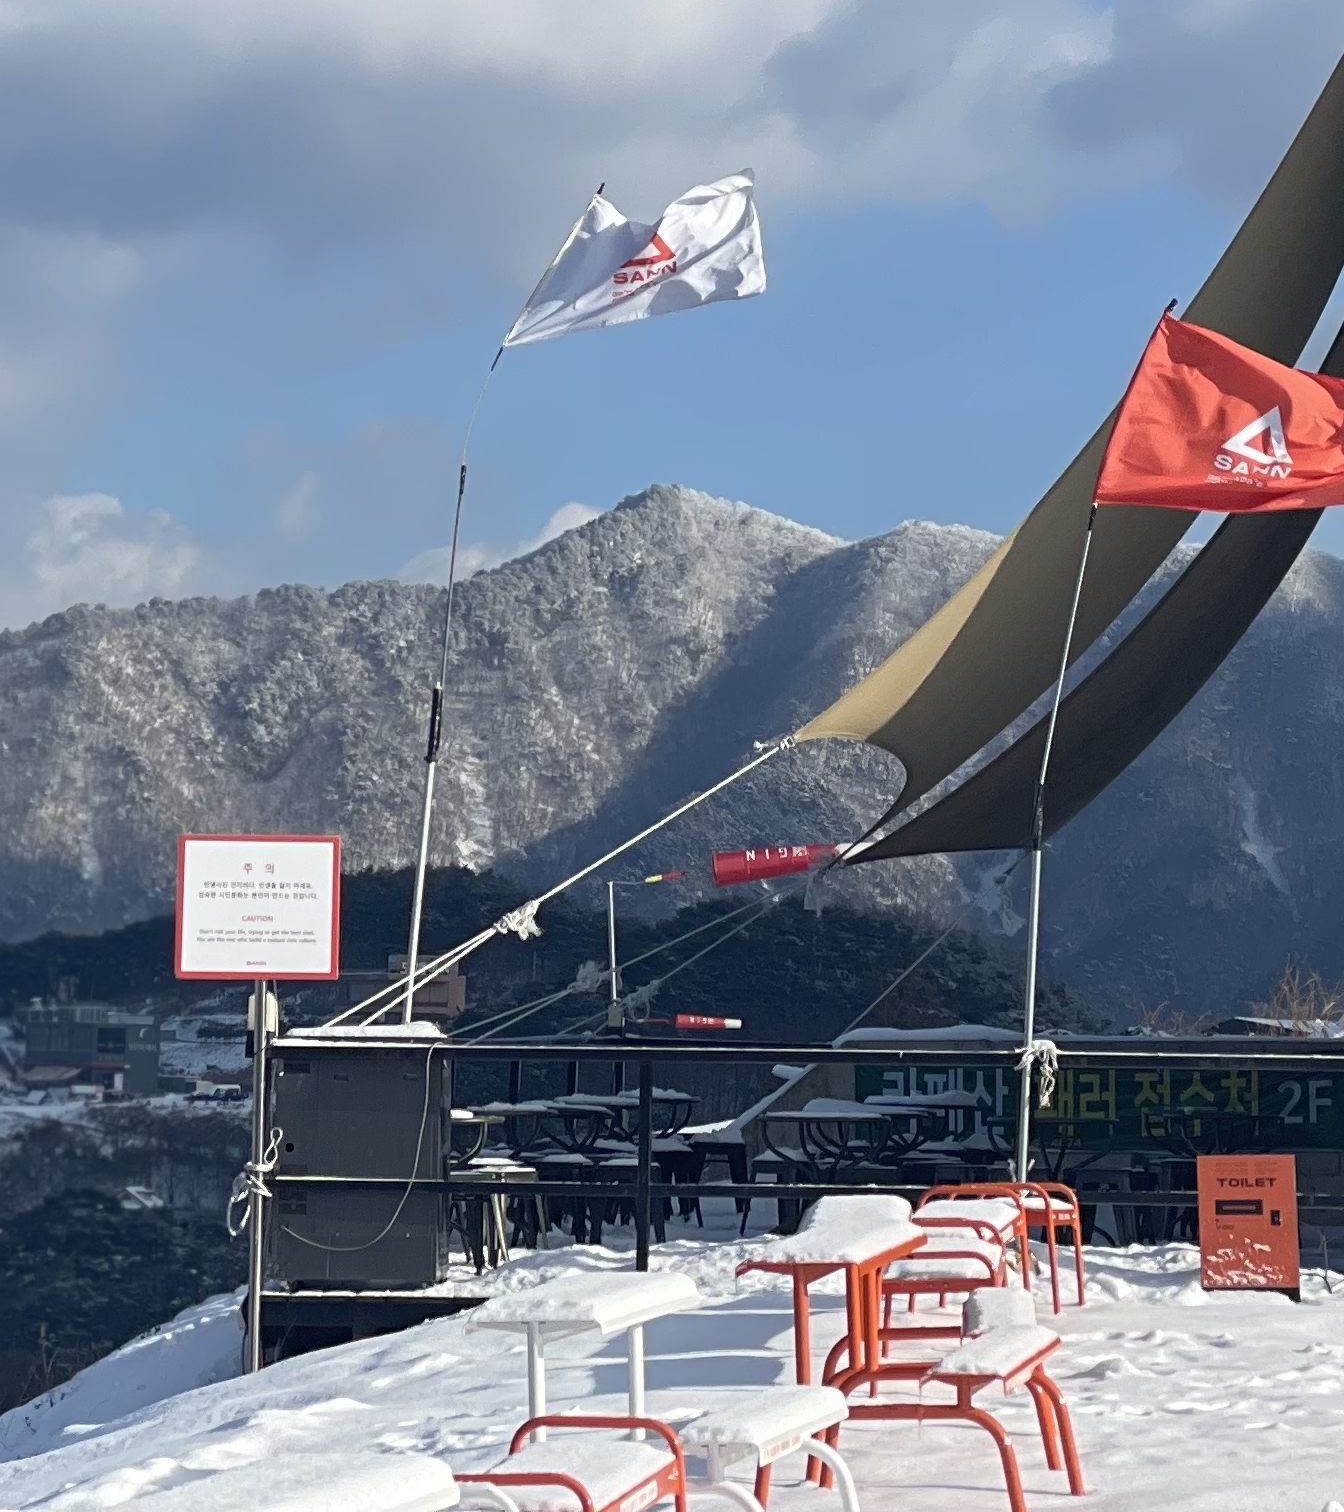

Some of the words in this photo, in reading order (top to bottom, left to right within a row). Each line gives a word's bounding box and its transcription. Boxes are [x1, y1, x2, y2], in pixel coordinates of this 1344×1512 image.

[613, 261, 677, 284] SANN
[241, 915, 274, 923] CAUTION
[1133, 1068, 1259, 1138] 접수처
[1276, 1079, 1334, 1125] 2F
[1216, 1176, 1278, 1188] TOILET
